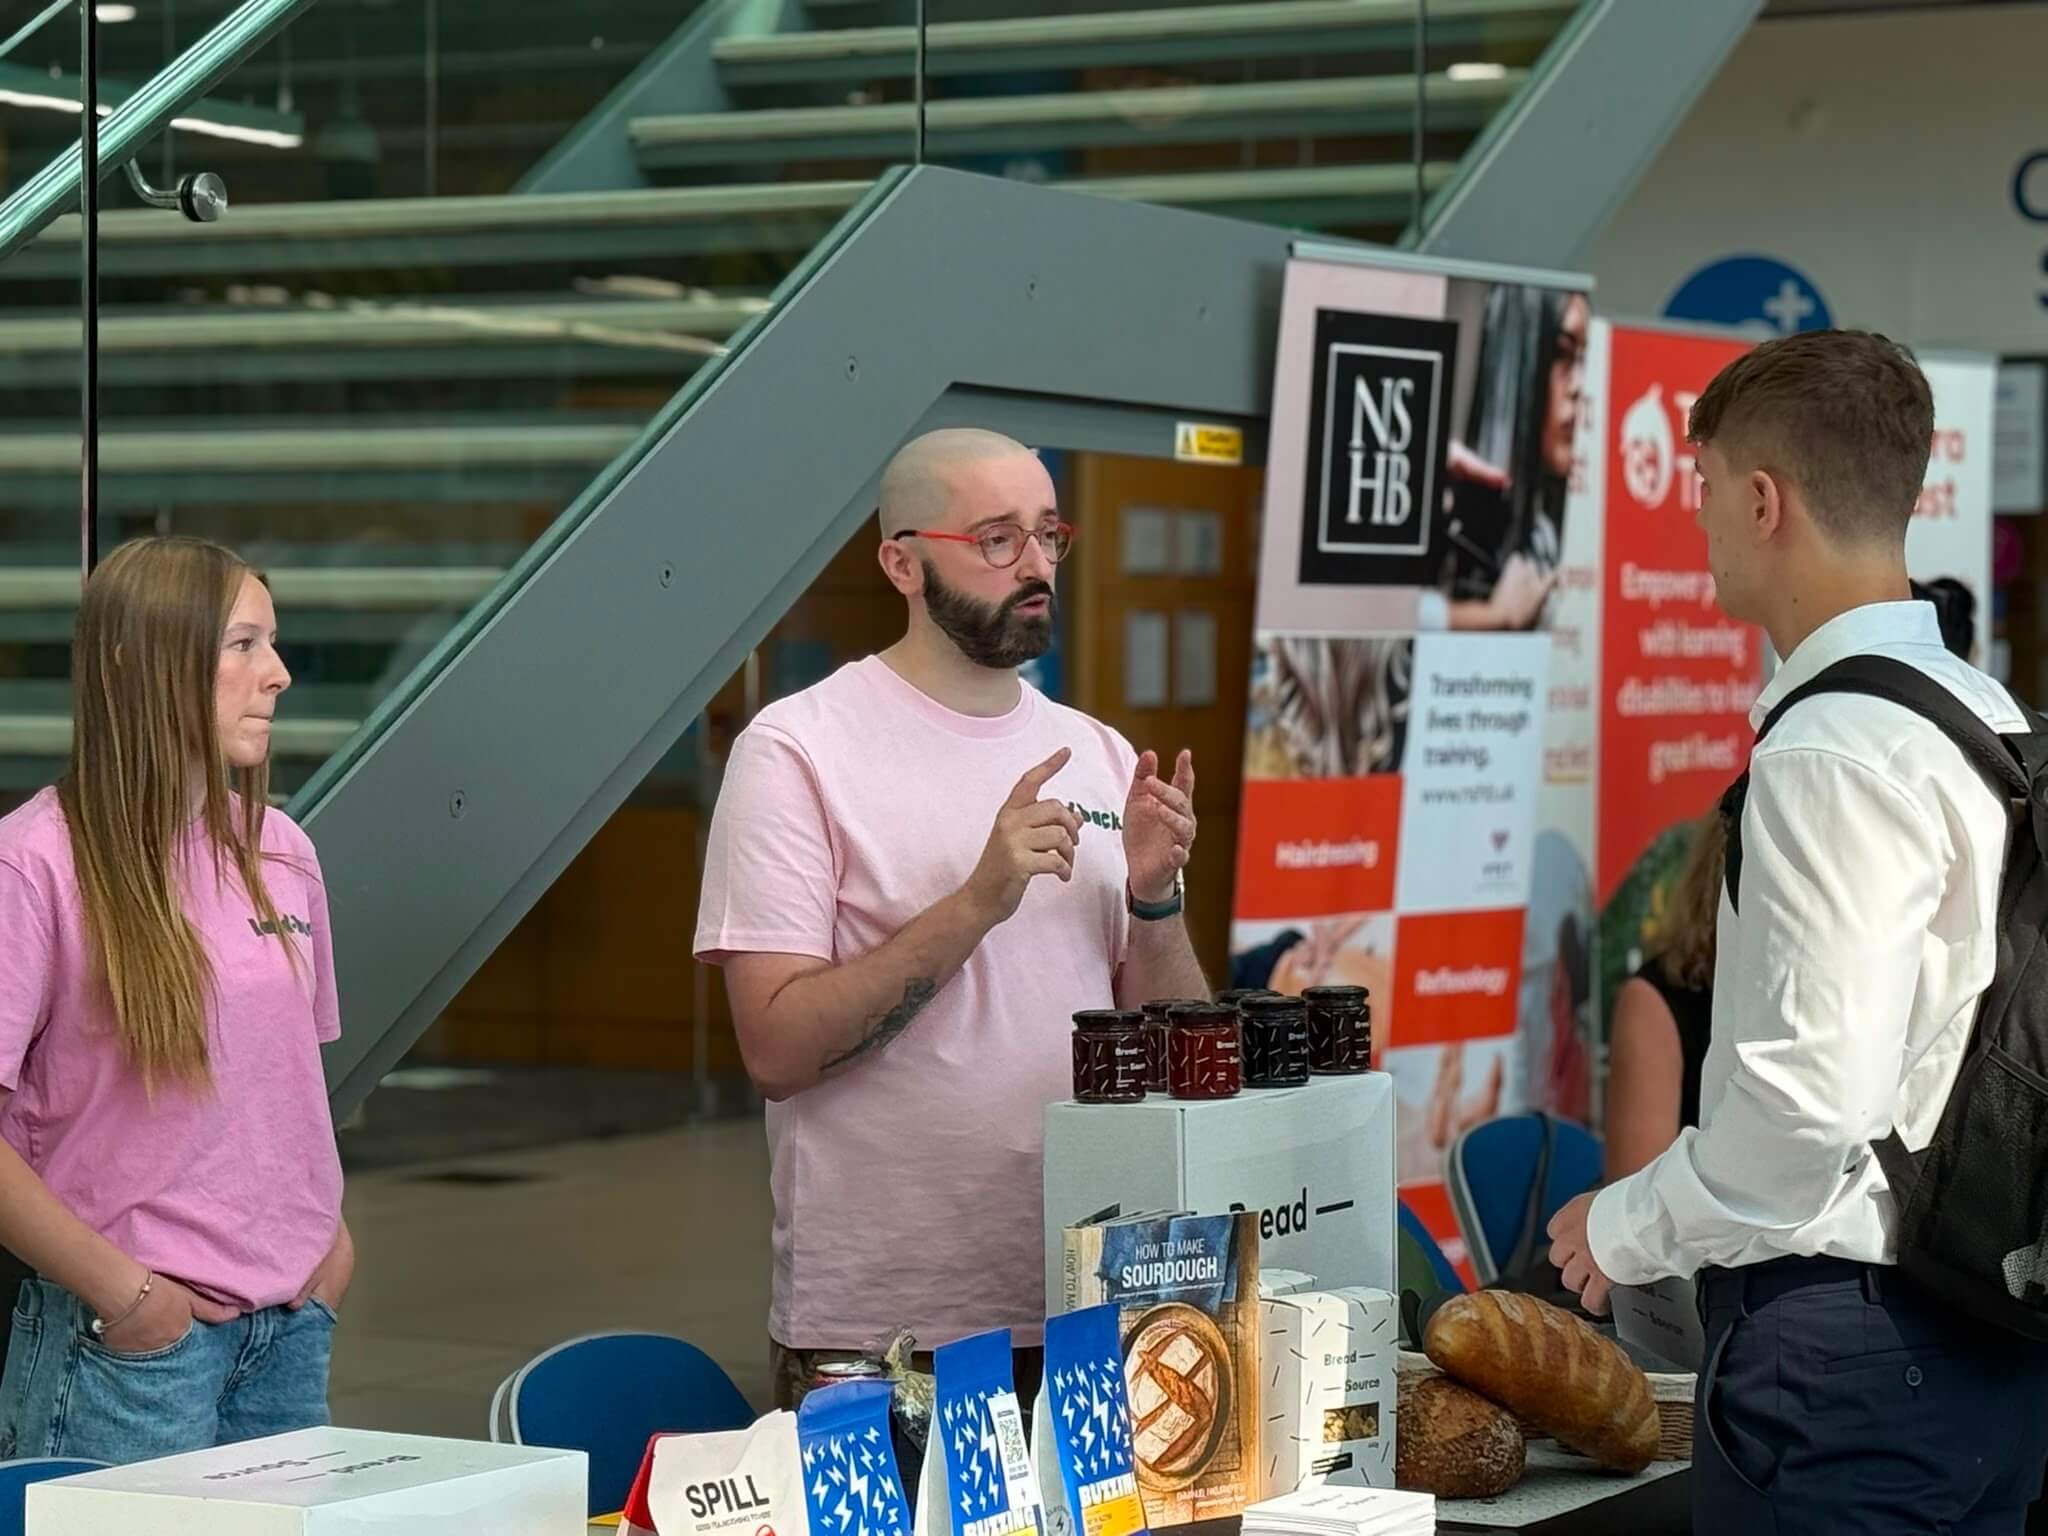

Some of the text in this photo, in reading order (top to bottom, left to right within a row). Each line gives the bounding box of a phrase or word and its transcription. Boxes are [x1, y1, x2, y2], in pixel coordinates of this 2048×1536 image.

[1349, 374, 1415, 452] NS
[1345, 450, 1412, 526] HB
[1431, 674, 1535, 701] Transforming
[1466, 707, 1529, 737] through
[1229, 1187, 1307, 1240] ead
[1135, 1238, 1206, 1260] HOW TO MAKE
[1064, 1249, 1077, 1313] HOW TO MA
[1122, 1256, 1218, 1288] SOURDOUGH
[1323, 1350, 1358, 1366] Bread
[1344, 1379, 1381, 1393] Source
[685, 1474, 770, 1518] SPILL
